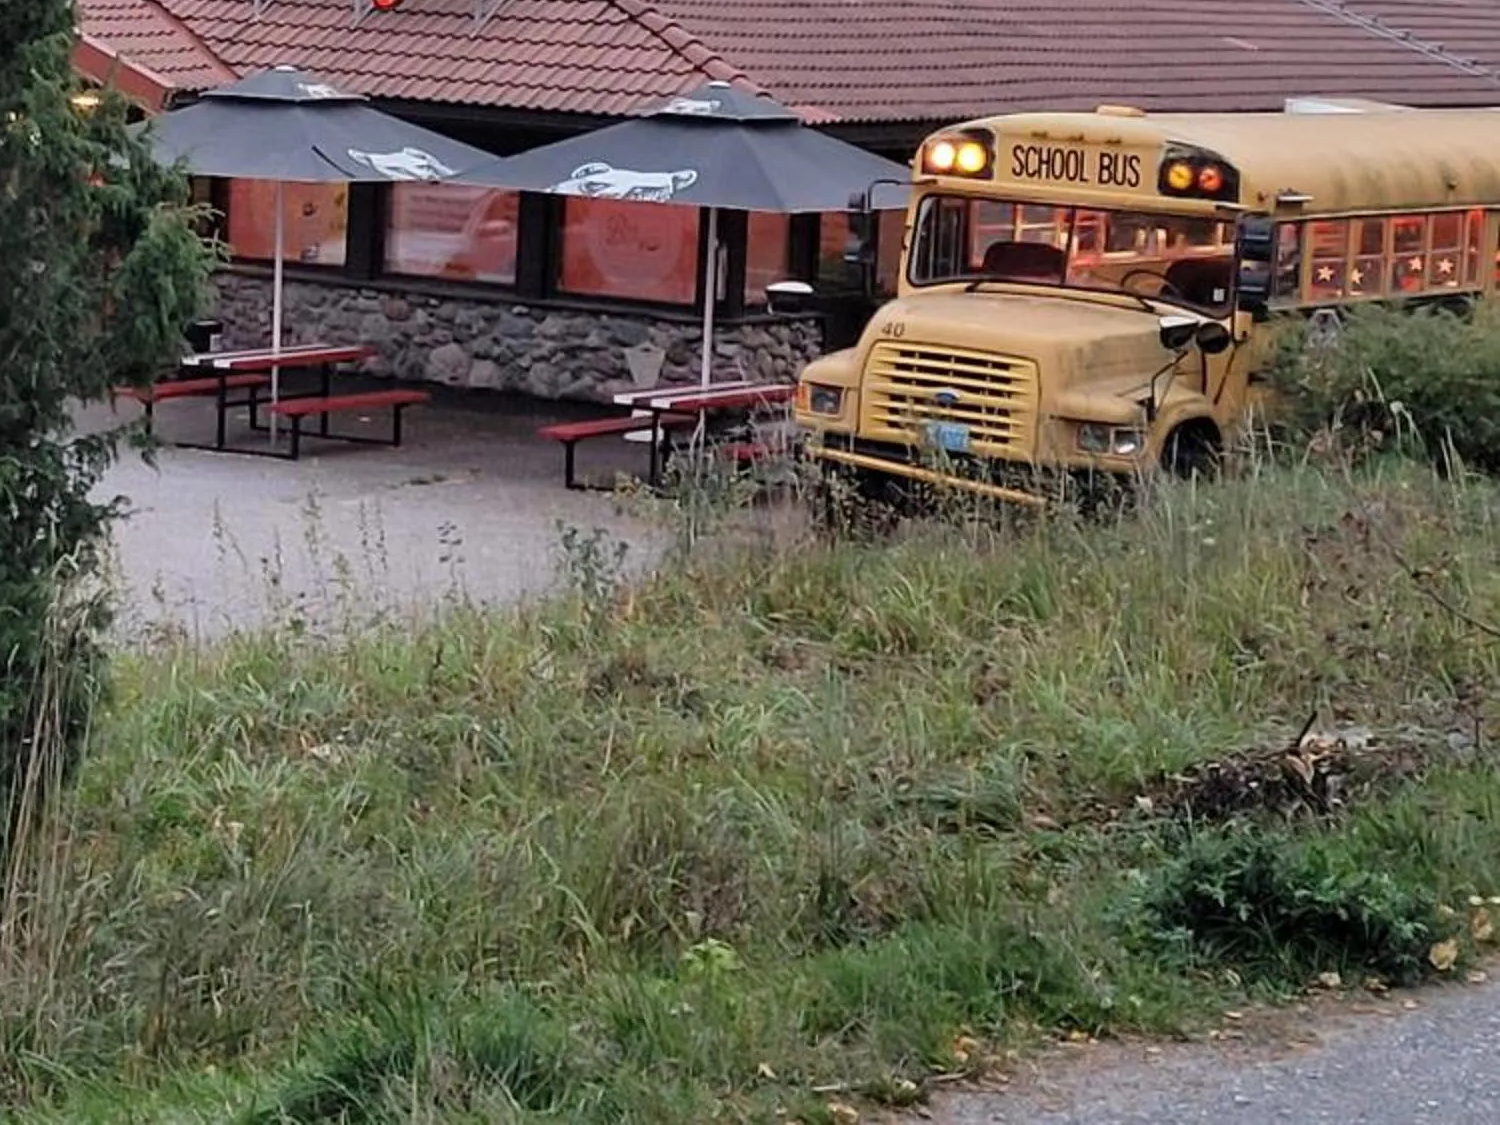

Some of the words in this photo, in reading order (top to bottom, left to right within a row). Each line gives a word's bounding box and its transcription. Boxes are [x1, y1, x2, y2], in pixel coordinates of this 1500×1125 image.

[1011, 144, 1089, 182] SCHOOL
[1098, 152, 1141, 187] BUS
[881, 322, 905, 337] 40
